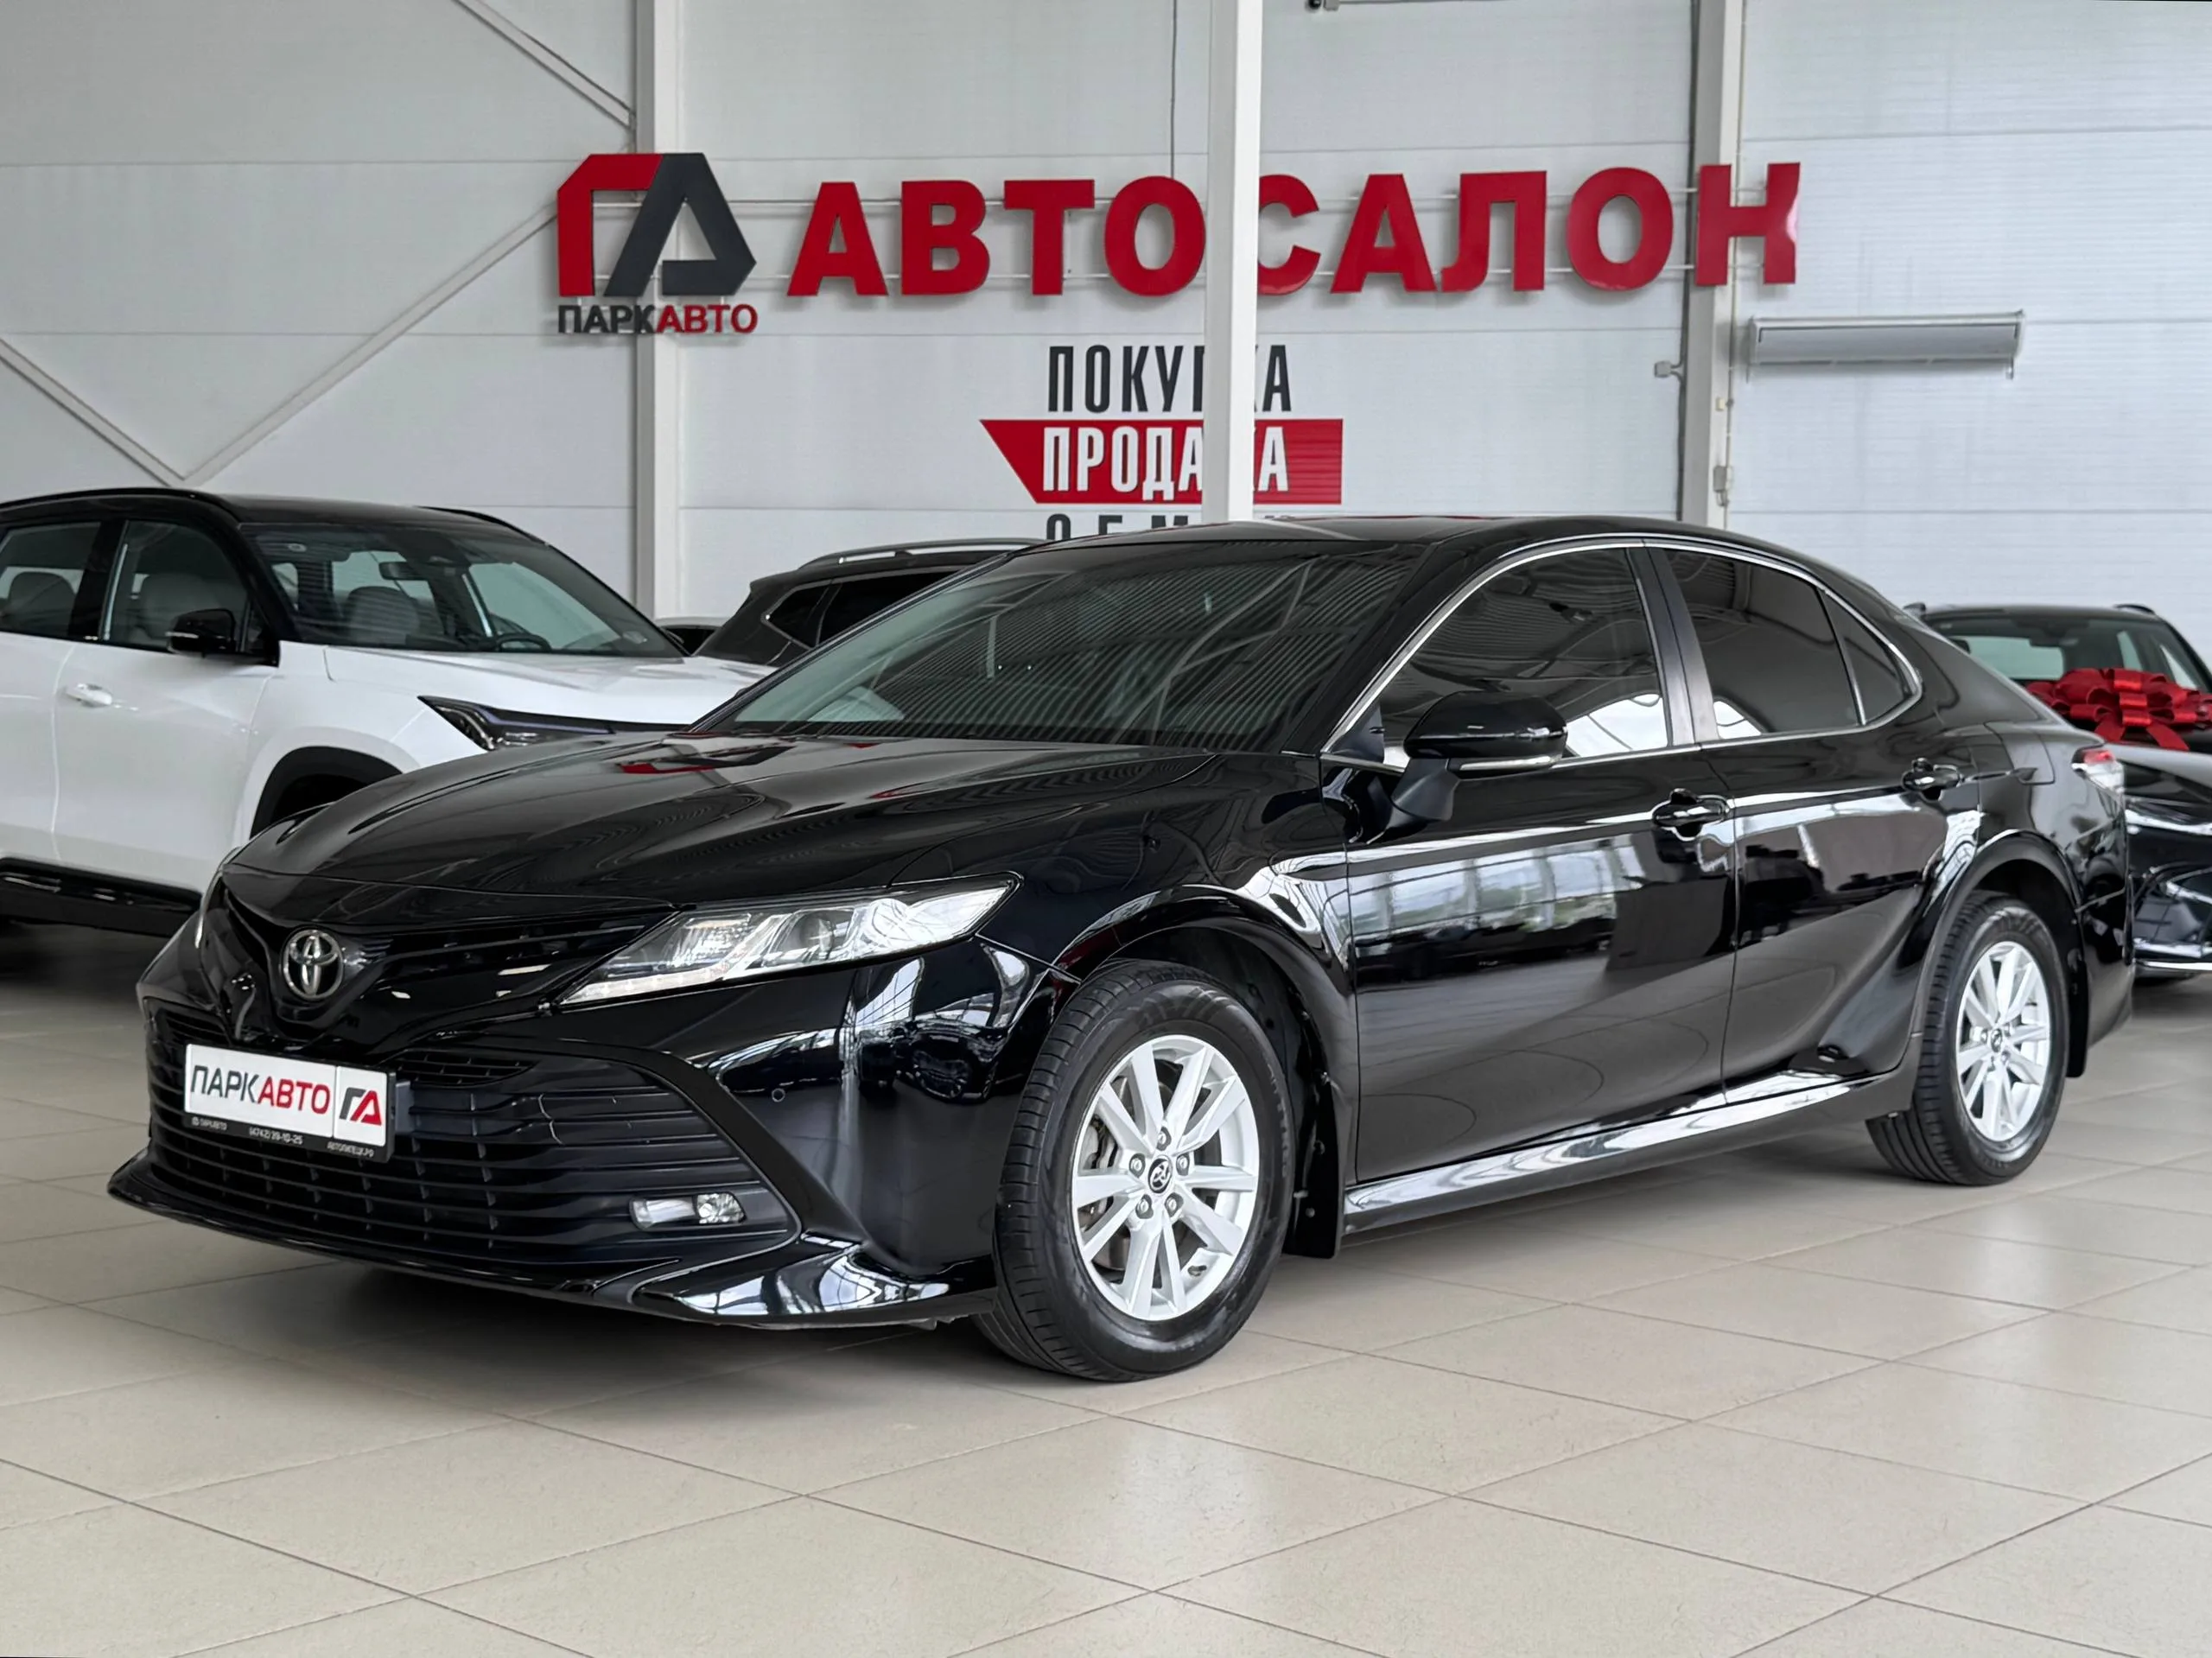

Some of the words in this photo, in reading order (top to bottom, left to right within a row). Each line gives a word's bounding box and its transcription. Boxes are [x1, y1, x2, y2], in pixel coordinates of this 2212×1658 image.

[787, 162, 1801, 297] АВТОСАЛОН
[558, 304, 758, 334] ПАРКАВТО
[1048, 345, 1292, 413] ПОКУА
[1043, 426, 1289, 501] ПРОДАА
[191, 1065, 331, 1115] ПАРКАВТО
